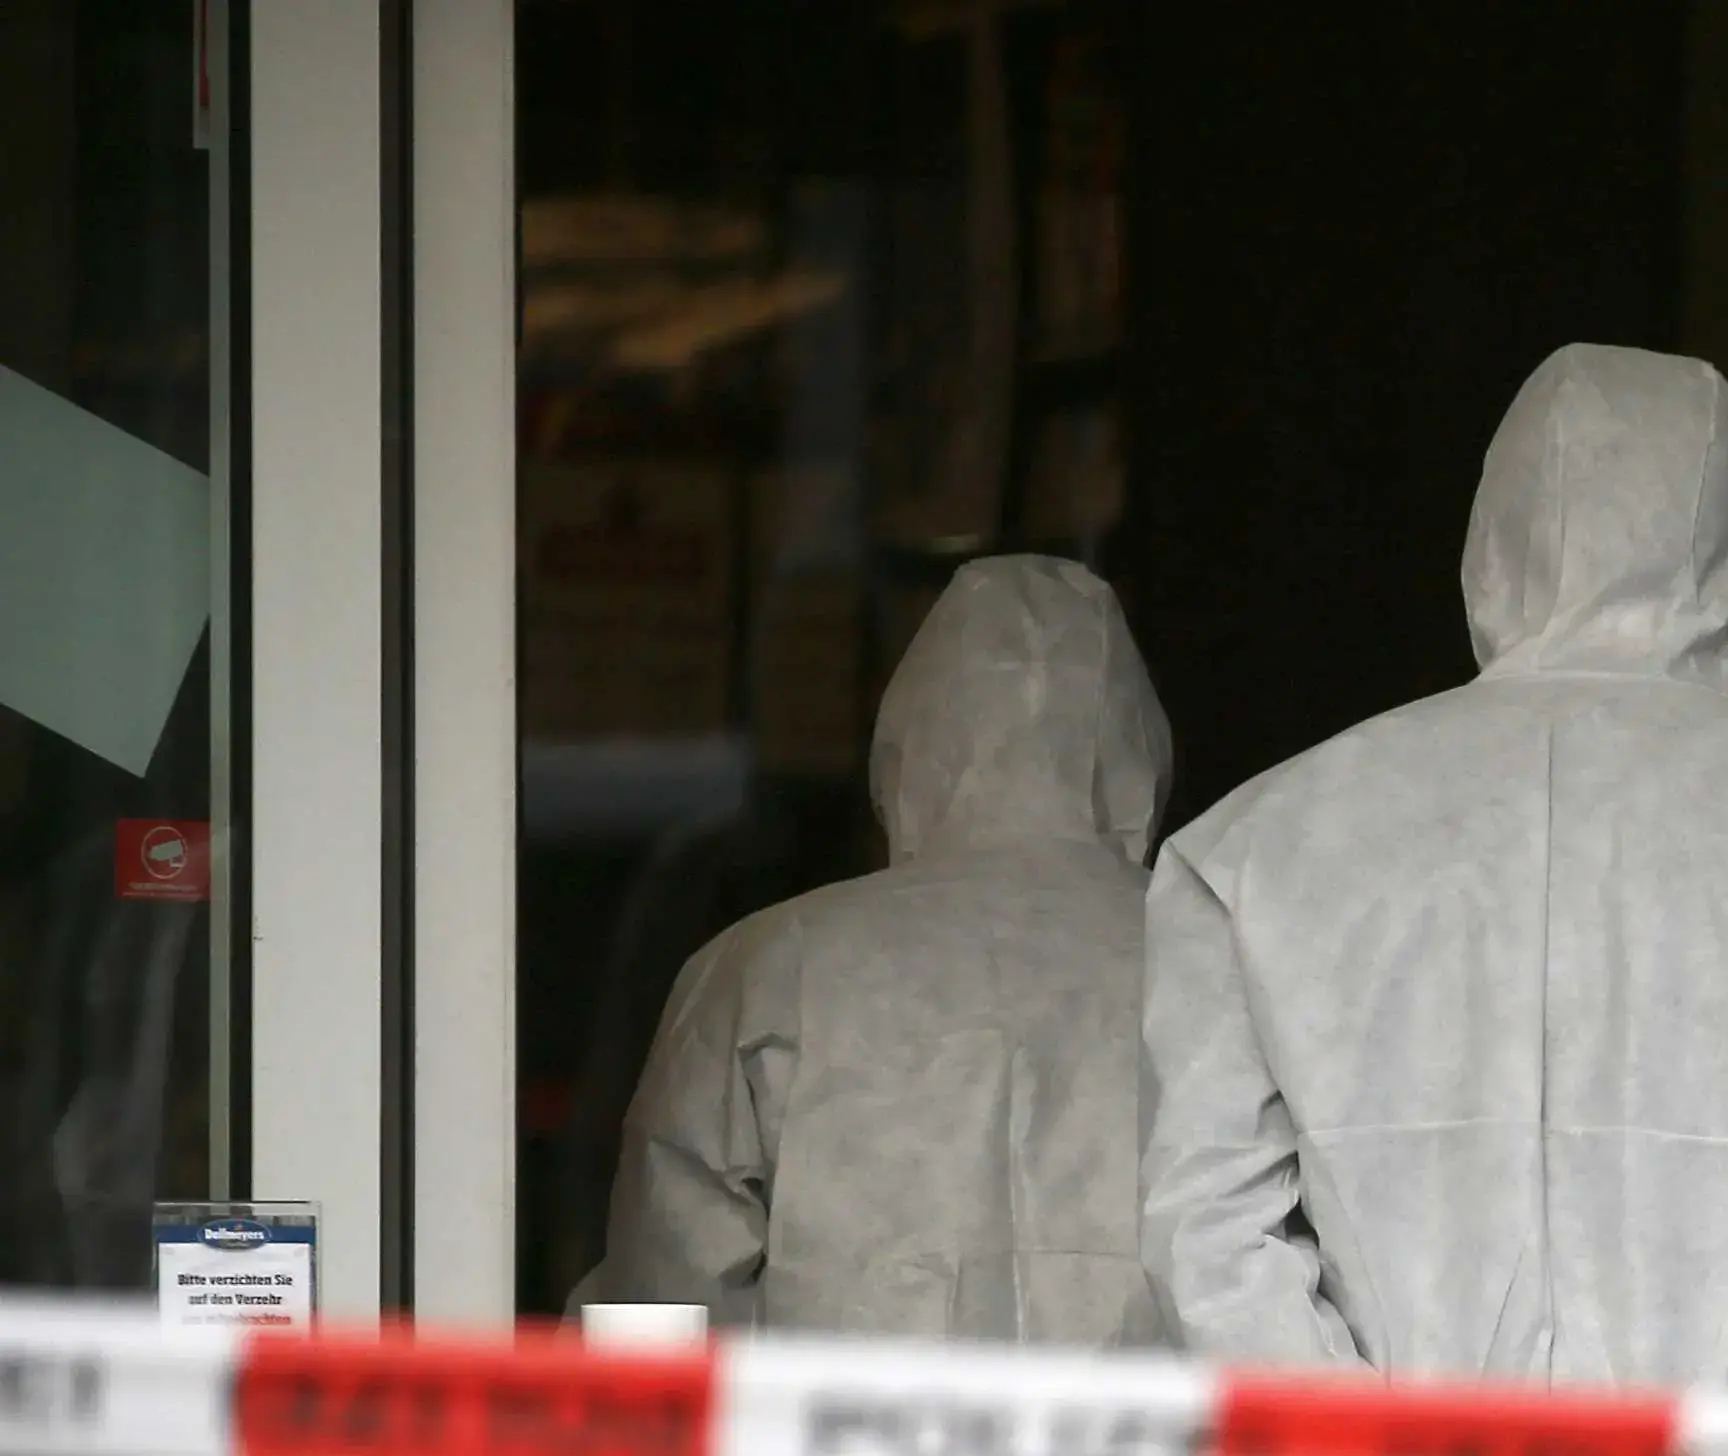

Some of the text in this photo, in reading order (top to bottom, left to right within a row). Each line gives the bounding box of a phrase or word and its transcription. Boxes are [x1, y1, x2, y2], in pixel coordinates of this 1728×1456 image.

[178, 1273, 293, 1286] Bitte verzichten Sie
[188, 1293, 283, 1305] auf den Verzehr
